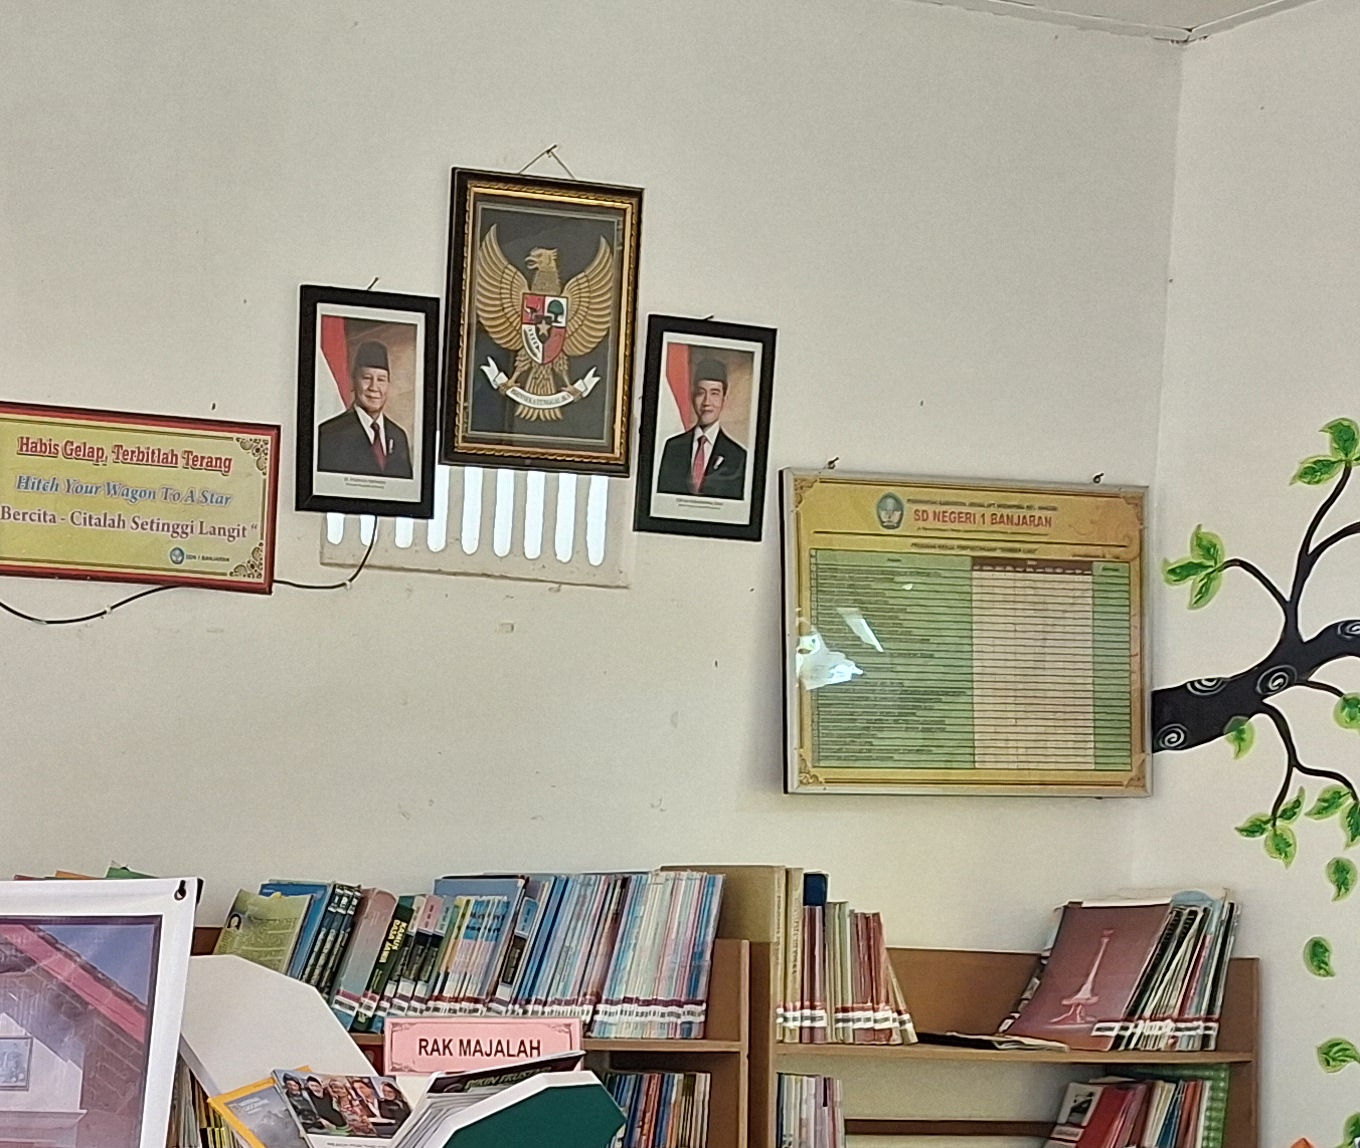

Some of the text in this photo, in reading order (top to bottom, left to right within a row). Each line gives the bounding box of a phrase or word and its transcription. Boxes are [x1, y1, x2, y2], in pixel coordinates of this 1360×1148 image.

[17, 436, 233, 475] Habis Gelap, Terbitlah Terang
[15, 475, 232, 506] Hitch Your Wagon To A Star
[0, 505, 247, 542] Bercita Citalah Setinggi Langit
[914, 509, 1052, 528] SD NEGERI 1 BANJARAN
[418, 1038, 541, 1058] RAK MAJALAH
